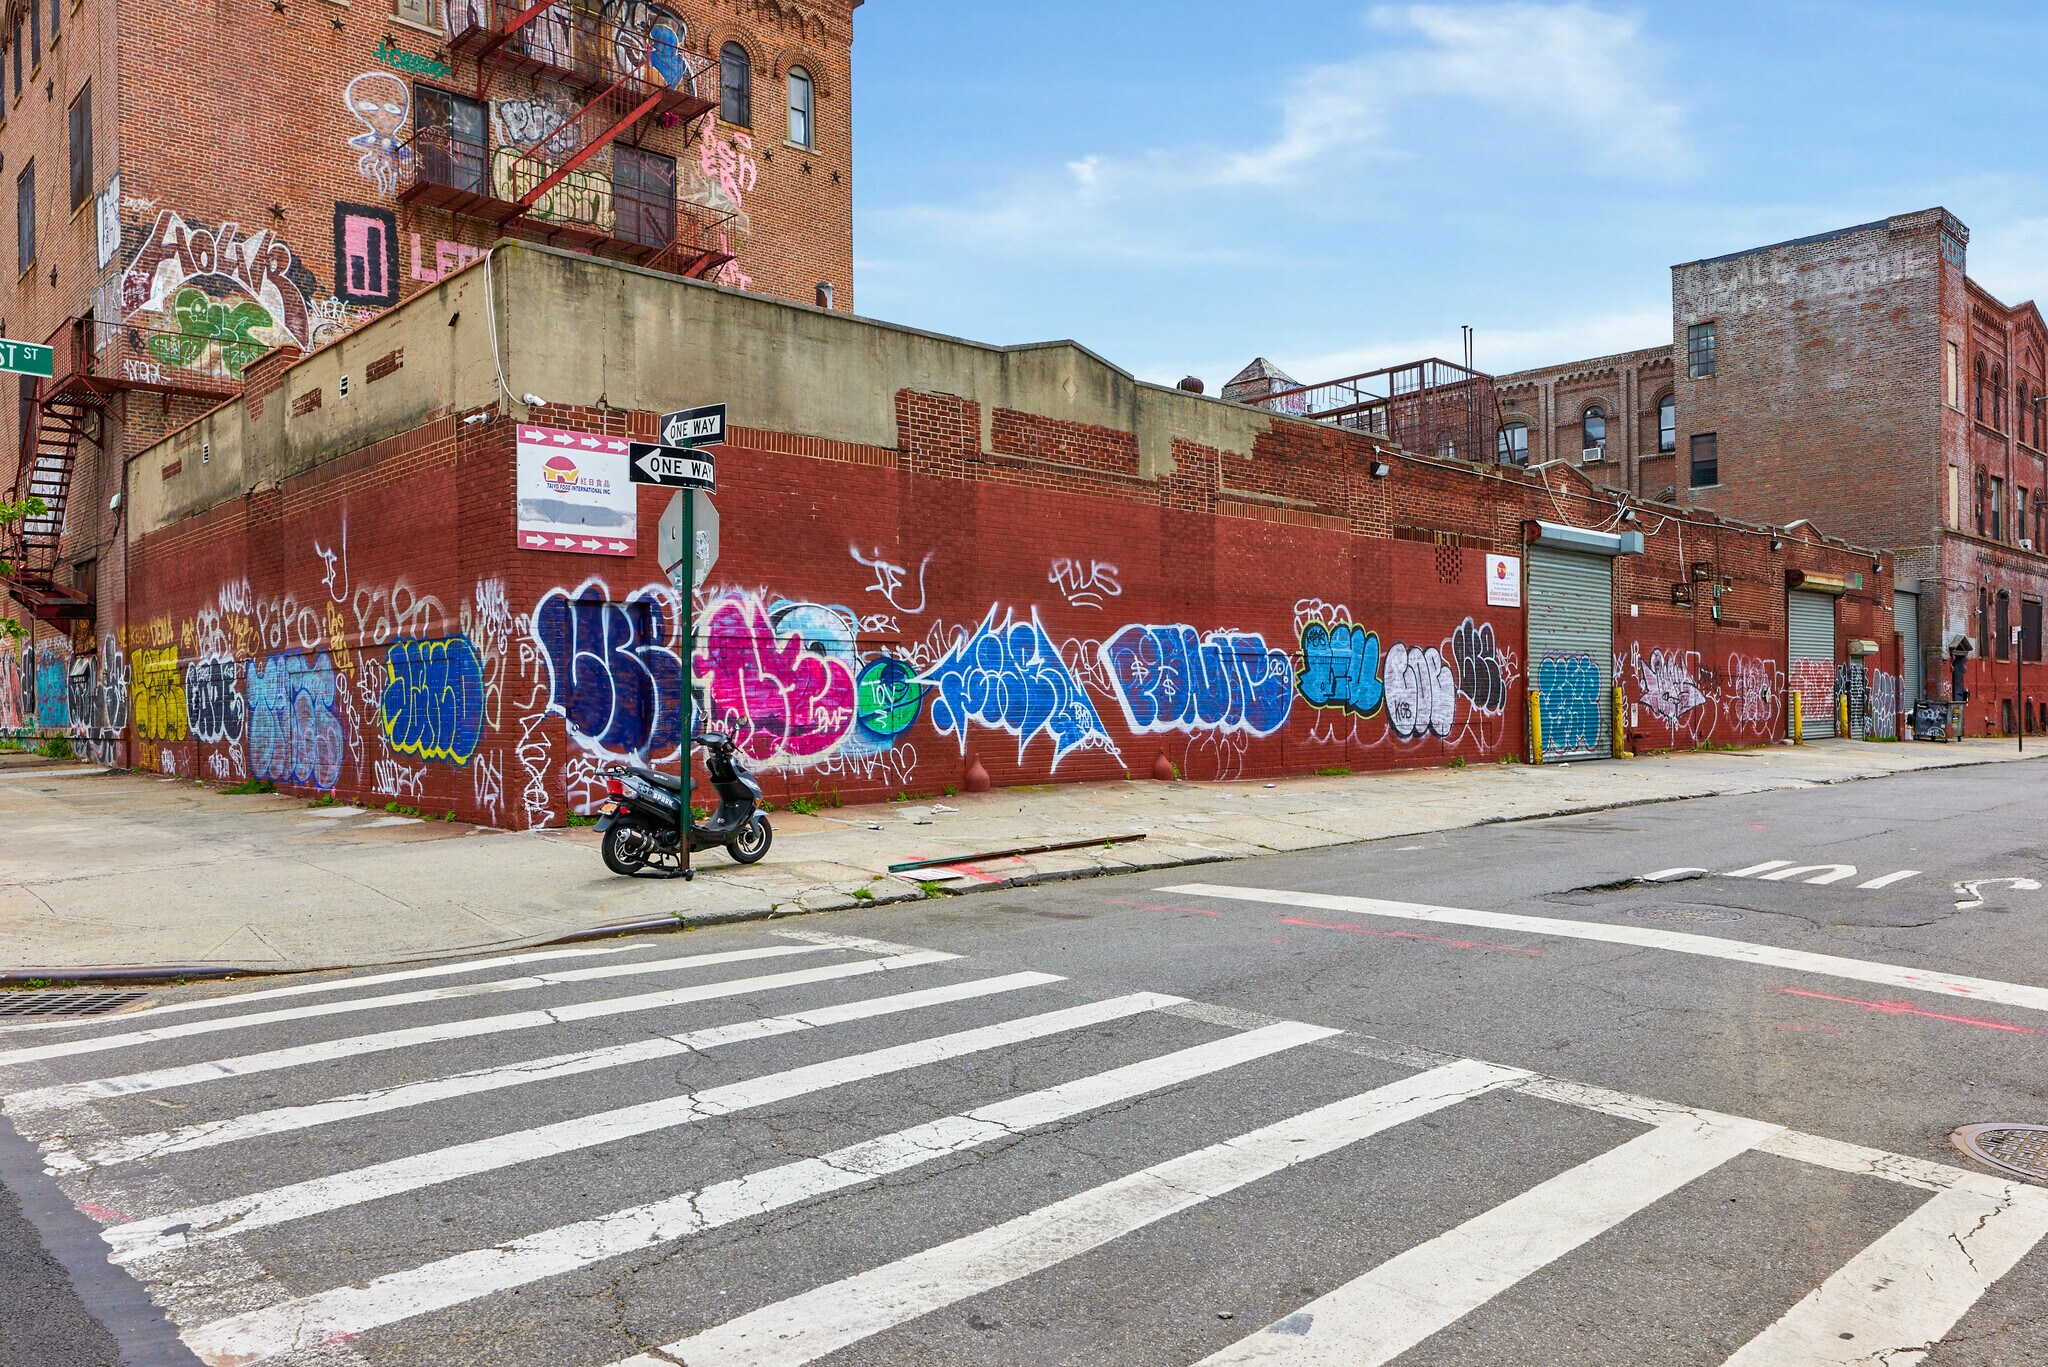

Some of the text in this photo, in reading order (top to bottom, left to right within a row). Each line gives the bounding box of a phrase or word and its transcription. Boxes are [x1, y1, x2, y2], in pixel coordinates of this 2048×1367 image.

[23, 347, 39, 361] ST
[670, 417, 716, 440] ONE WAY
[650, 457, 712, 480] ONE WAY
[571, 485, 602, 494] INTERNATIONAL
